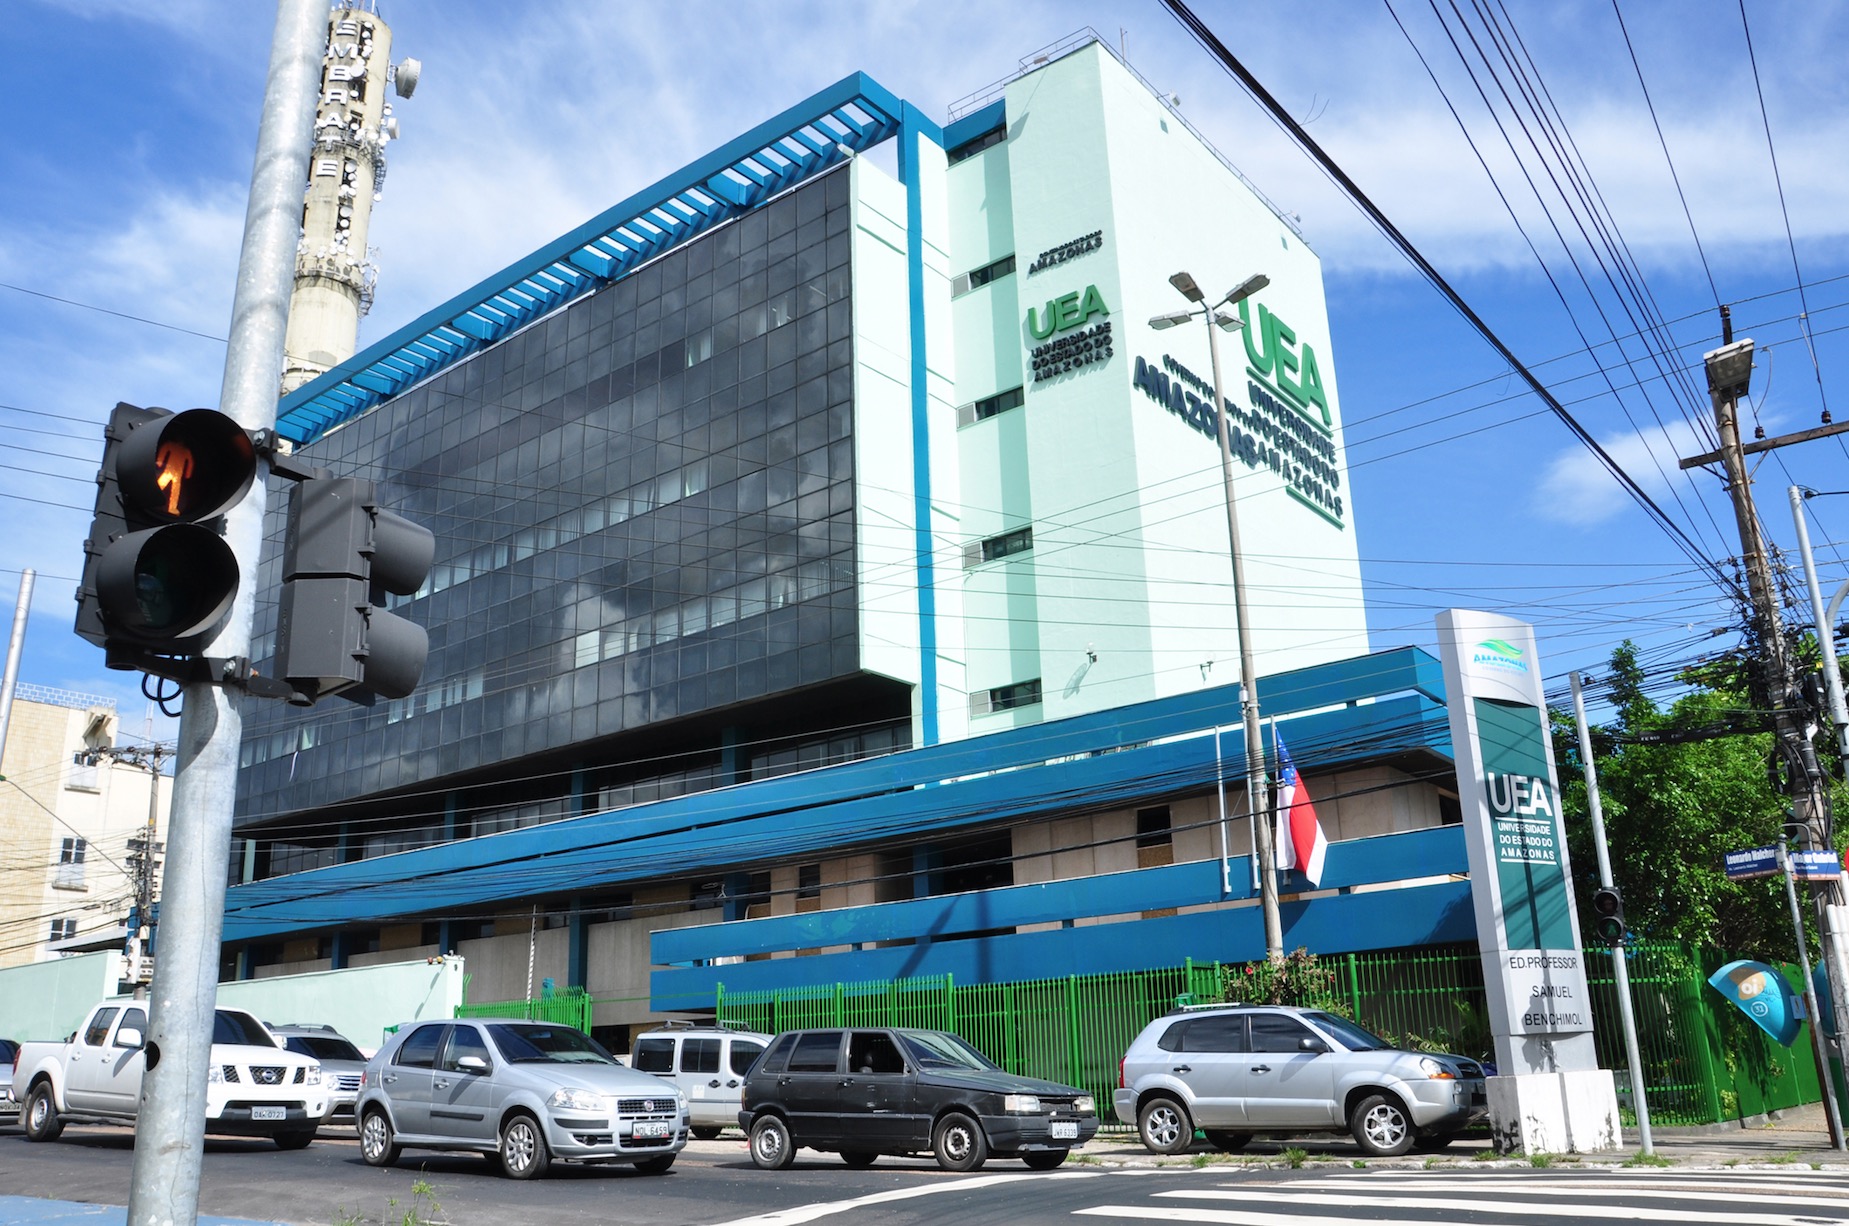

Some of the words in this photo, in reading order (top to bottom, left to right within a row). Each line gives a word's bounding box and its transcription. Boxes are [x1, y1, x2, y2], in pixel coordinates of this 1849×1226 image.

[1029, 236, 1103, 275] AMAZONAS
[1027, 284, 1110, 341] UEA
[1031, 321, 1112, 359] UNIVERSIDADE
[1032, 357, 1050, 371] DO
[1048, 341, 1093, 365] ESTADO
[1093, 334, 1113, 350] DO
[1034, 346, 1114, 383] AMAZONAS
[1237, 297, 1333, 429] UEA
[1247, 380, 1337, 467] UNIVERSIDADE
[1257, 441, 1344, 519] AMAZONAS
[1488, 772, 1553, 816] UEA
[1497, 822, 1551, 835] UNIVERSIDADE
[1500, 834, 1511, 844] DO
[1512, 835, 1541, 846] ESTADO
[1542, 837, 1553, 848] DO
[1501, 847, 1555, 860] AMAZONAS
[1532, 985, 1573, 998] SAMUEL
[1741, 978, 1758, 995] oi
[1524, 1013, 1583, 1026] BENCHIMOL
